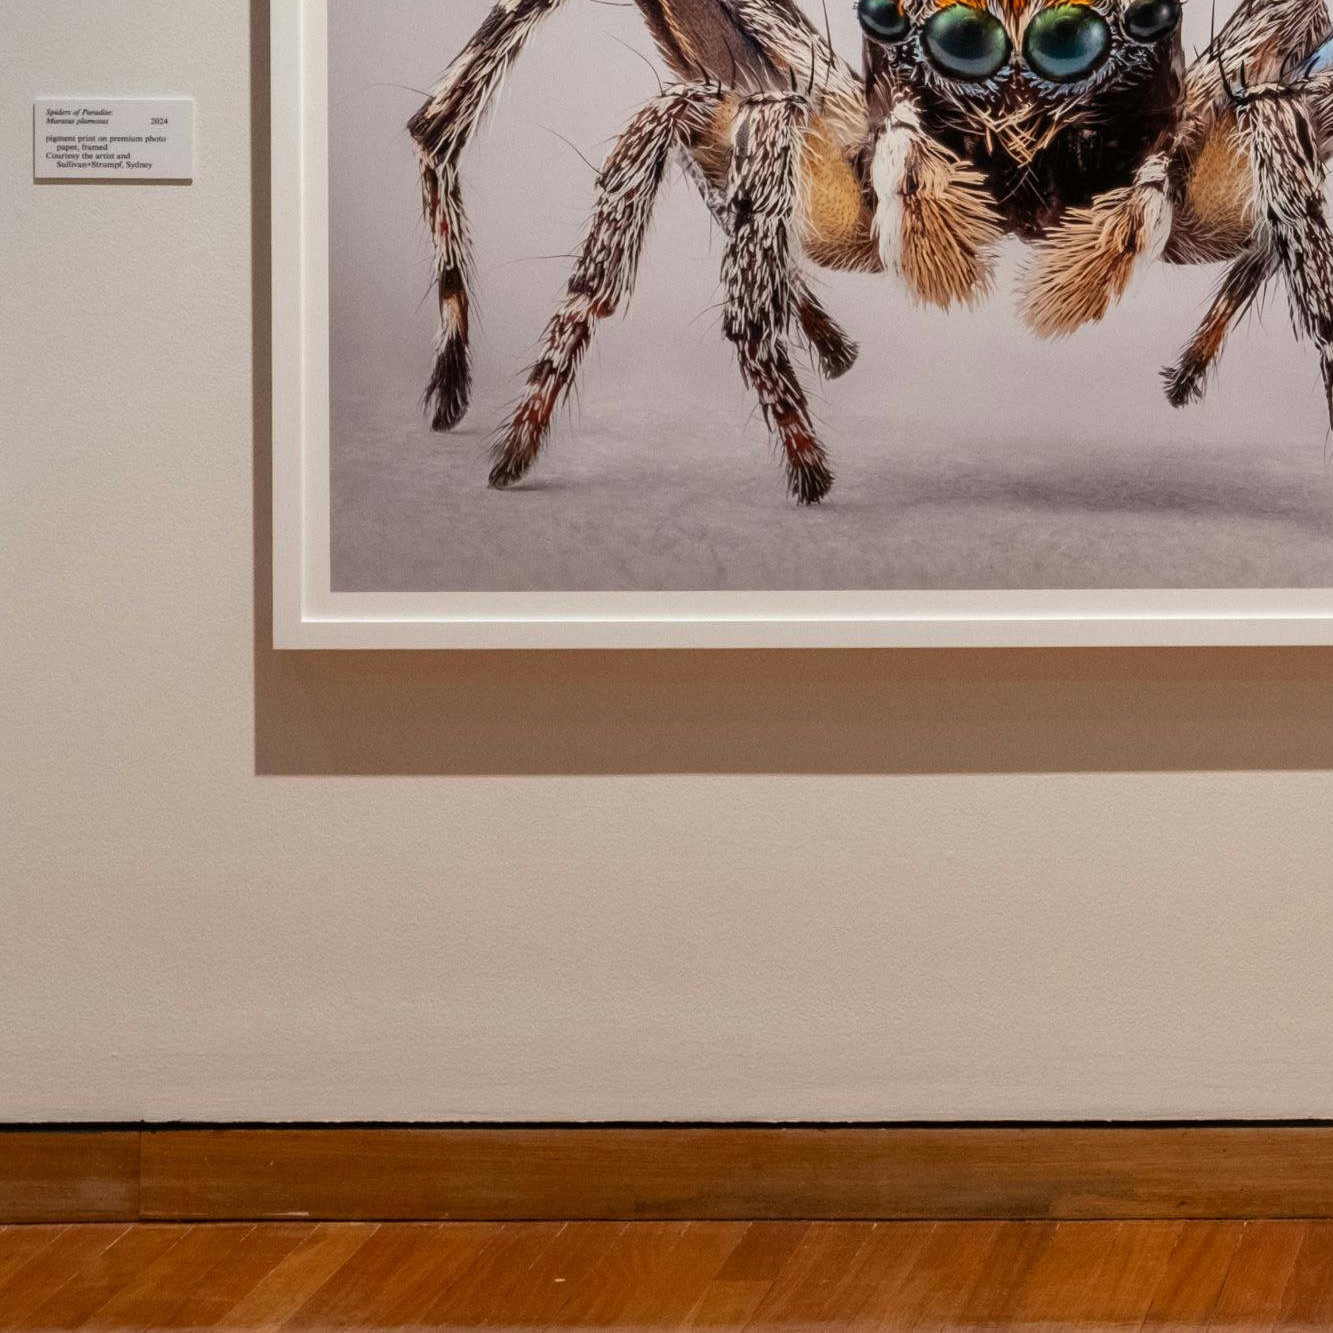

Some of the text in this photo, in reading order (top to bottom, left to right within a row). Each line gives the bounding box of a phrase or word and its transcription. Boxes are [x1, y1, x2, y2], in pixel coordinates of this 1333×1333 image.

[150, 117, 168, 125] 2024
[45, 135, 76, 144] pigment
[77, 134, 96, 144] print
[109, 135, 143, 143] premium
[145, 134, 167, 143] photo
[81, 143, 108, 151] framed
[45, 152, 80, 160] Courtesy
[125, 160, 153, 170] Sydney
